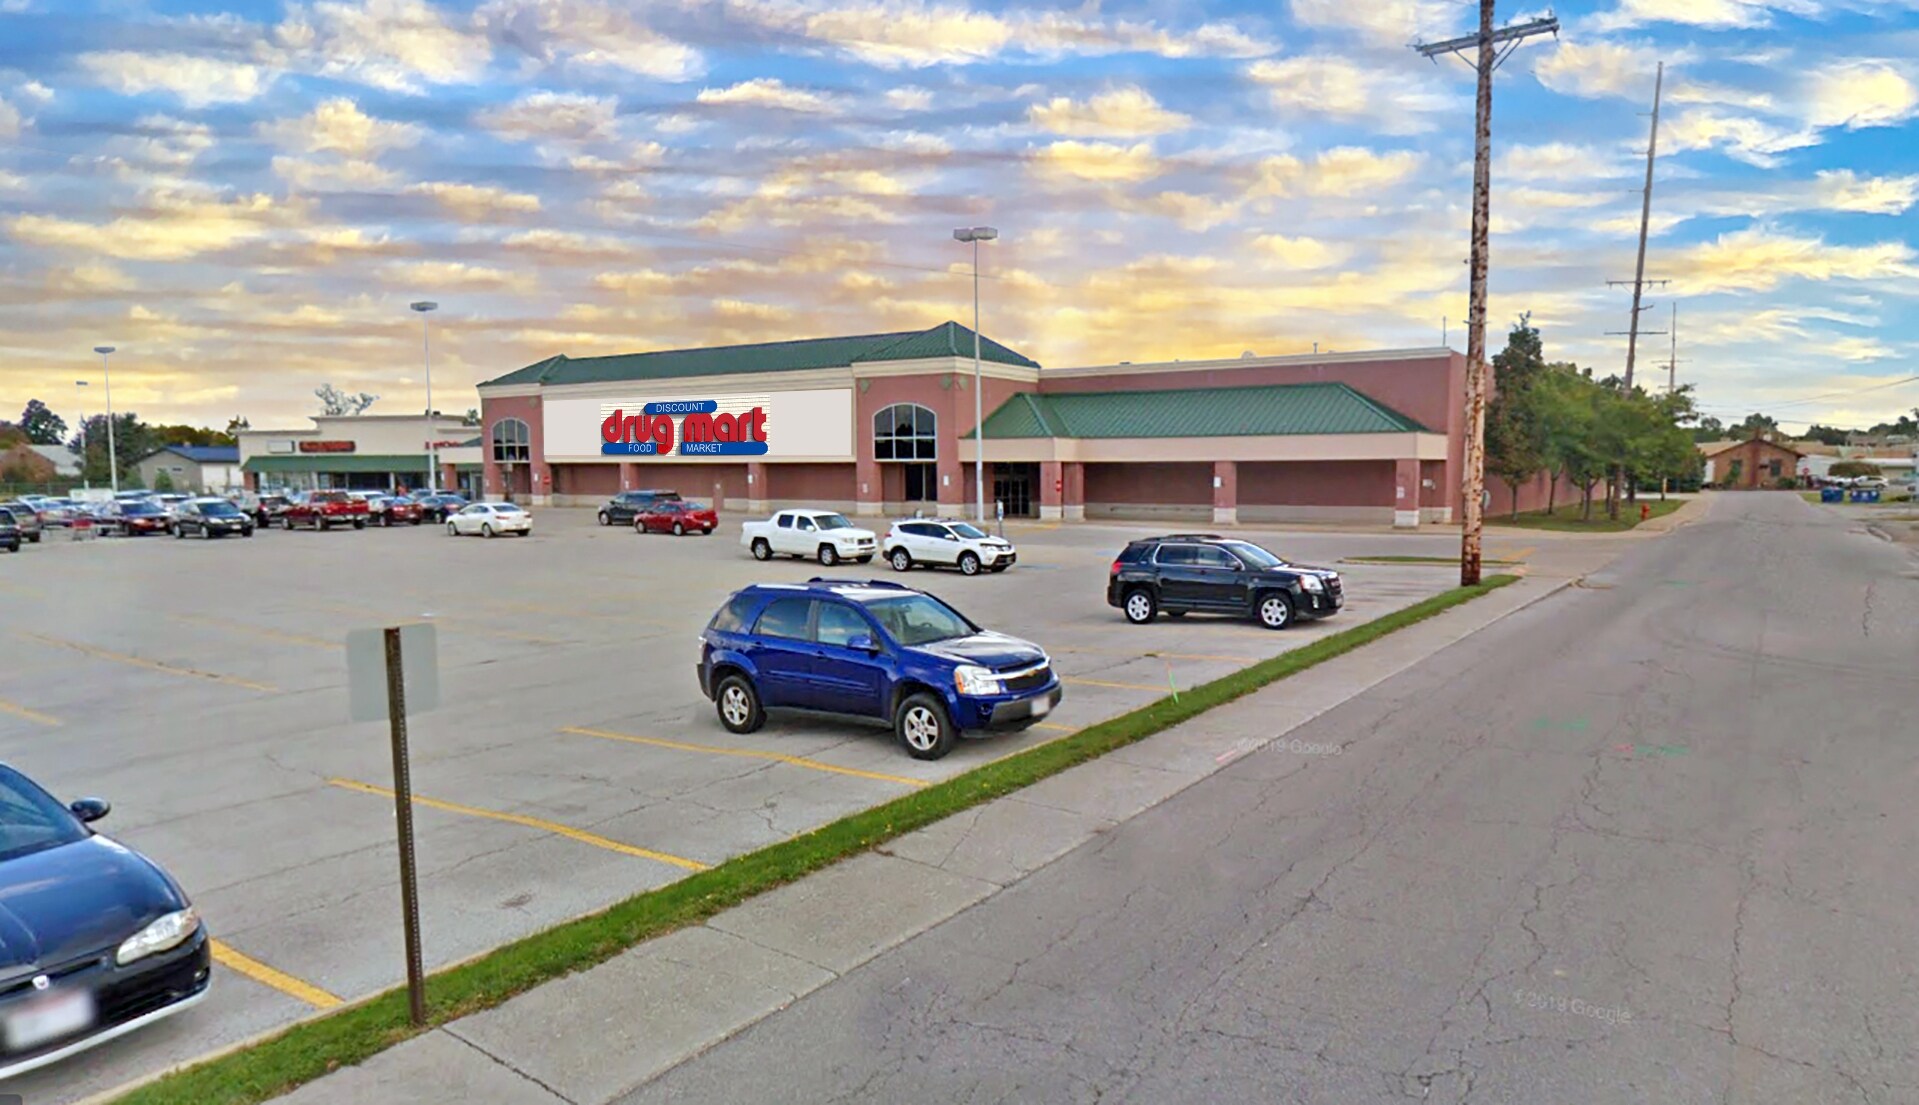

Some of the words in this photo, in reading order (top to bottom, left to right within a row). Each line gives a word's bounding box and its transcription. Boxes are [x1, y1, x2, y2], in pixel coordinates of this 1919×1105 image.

[655, 402, 705, 413] DISCOUNT
[602, 408, 675, 455] drug
[684, 406, 768, 442] mart
[628, 443, 652, 453] FOOD
[686, 443, 723, 453] MARKET
